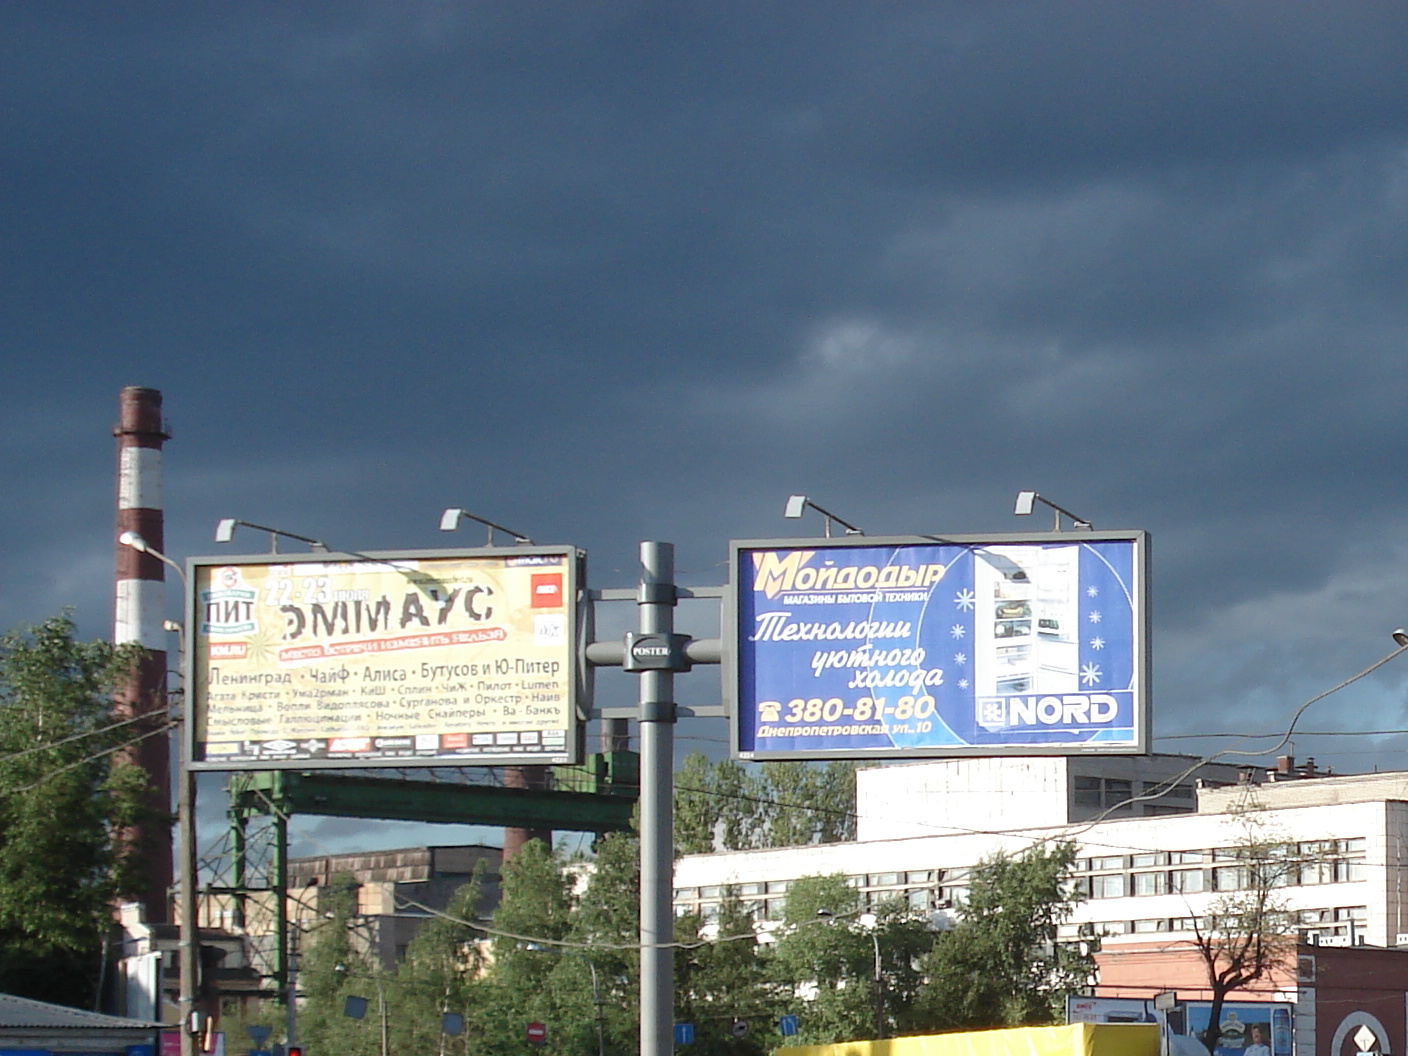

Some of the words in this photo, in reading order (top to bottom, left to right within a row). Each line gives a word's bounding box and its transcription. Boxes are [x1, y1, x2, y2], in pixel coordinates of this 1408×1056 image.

[783, 594, 836, 605] МАГАЗИНЫ
[837, 591, 883, 604] БЫТОВОЙ
[885, 592, 930, 603] ТЕХНИКИ
[206, 599, 255, 624] ПИТ
[748, 611, 912, 641] Технологии
[633, 646, 671, 656] POSTER
[811, 644, 926, 677] уютного
[208, 667, 292, 687] Ленинград
[362, 665, 407, 682] Алиса
[421, 662, 479, 682] Бутусов
[482, 663, 491, 676] и
[495, 658, 560, 678] Ю-Питер
[848, 668, 944, 696] холода
[397, 683, 433, 695] Сплин
[477, 680, 513, 692] Пилот
[521, 679, 560, 690] Lumen
[398, 696, 458, 710] Сурганова
[474, 693, 523, 706] Оркестр
[531, 692, 561, 703] Наив
[785, 695, 936, 723] 380-81-80
[1009, 694, 1119, 726] NORD
[374, 710, 420, 722] Ночные
[757, 723, 889, 738] Днепропетровская
